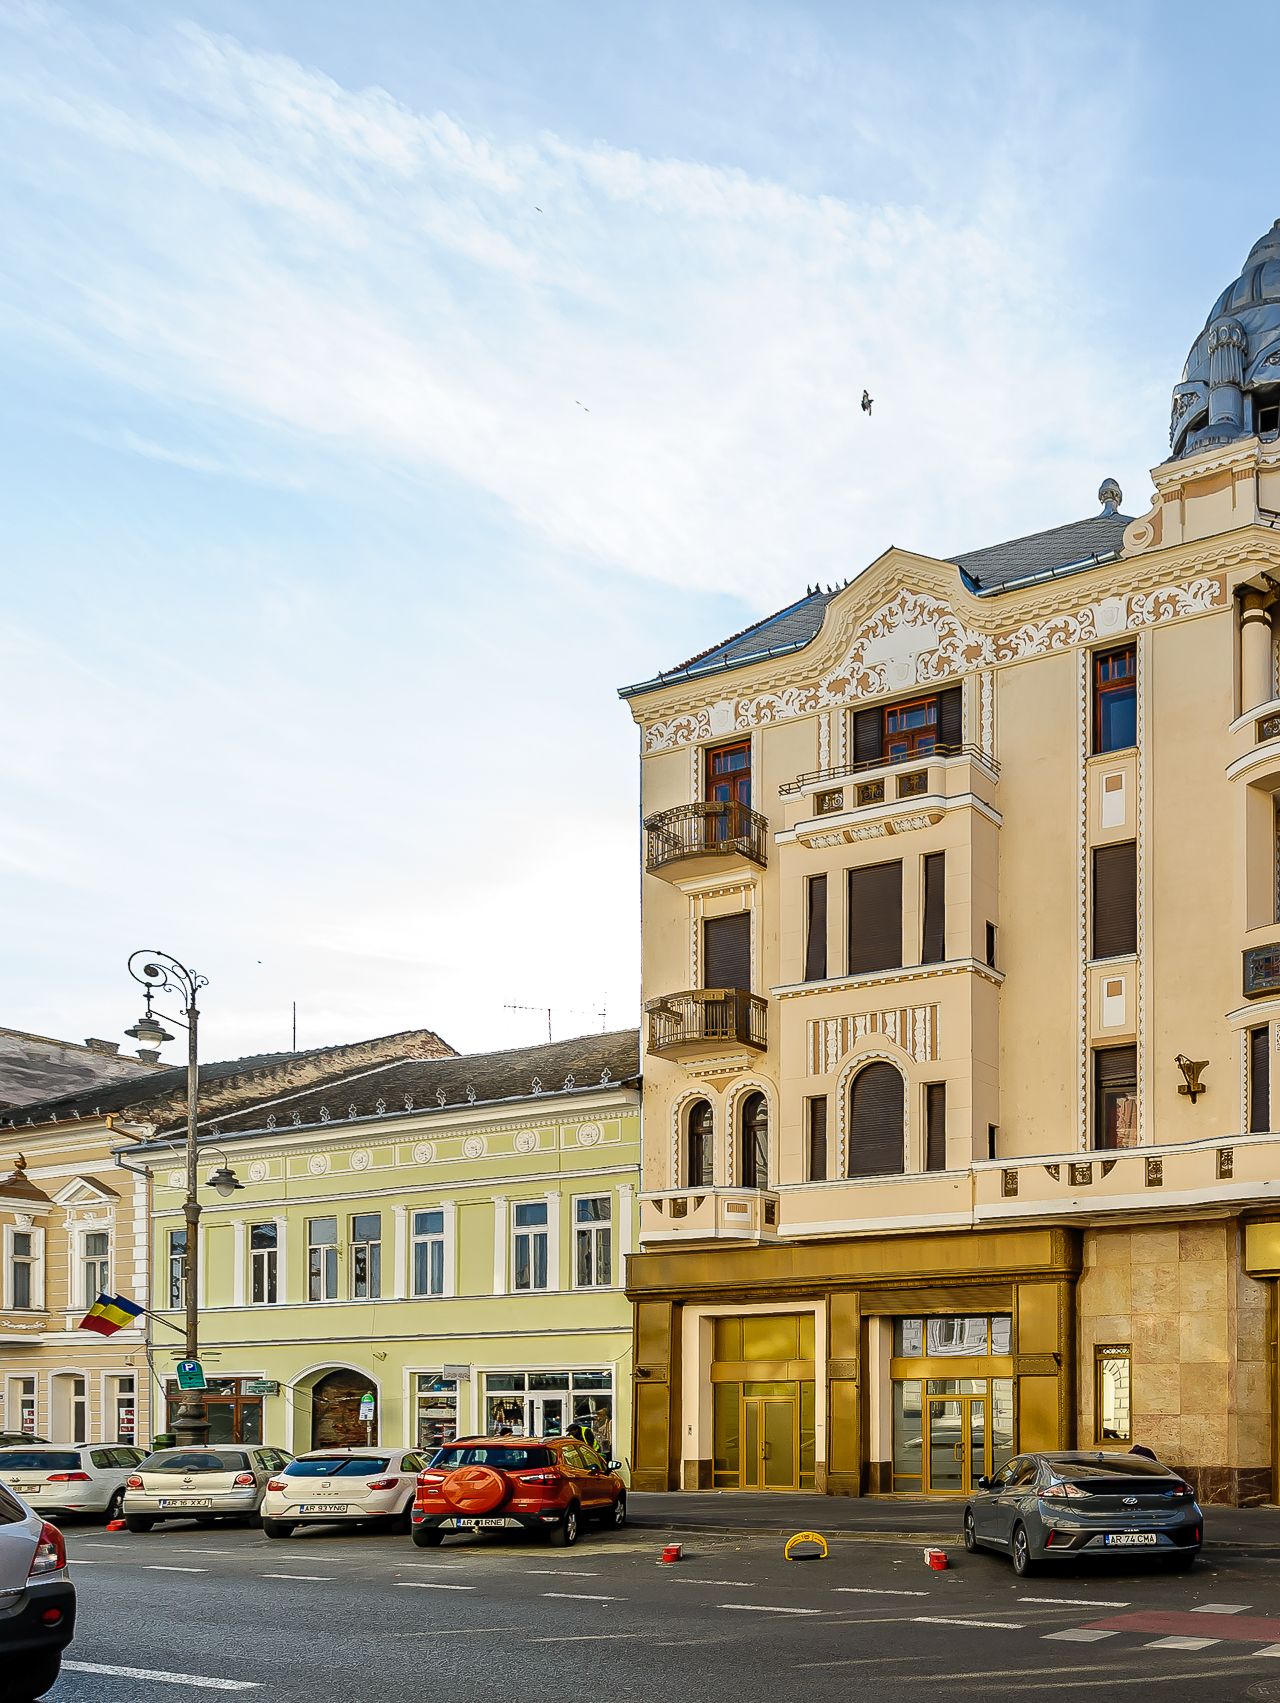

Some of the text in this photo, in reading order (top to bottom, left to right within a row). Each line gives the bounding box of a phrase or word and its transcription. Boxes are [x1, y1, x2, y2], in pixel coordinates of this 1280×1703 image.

[184, 1363, 194, 1372] P
[1111, 1535, 1154, 1543] AR 74 CMA
